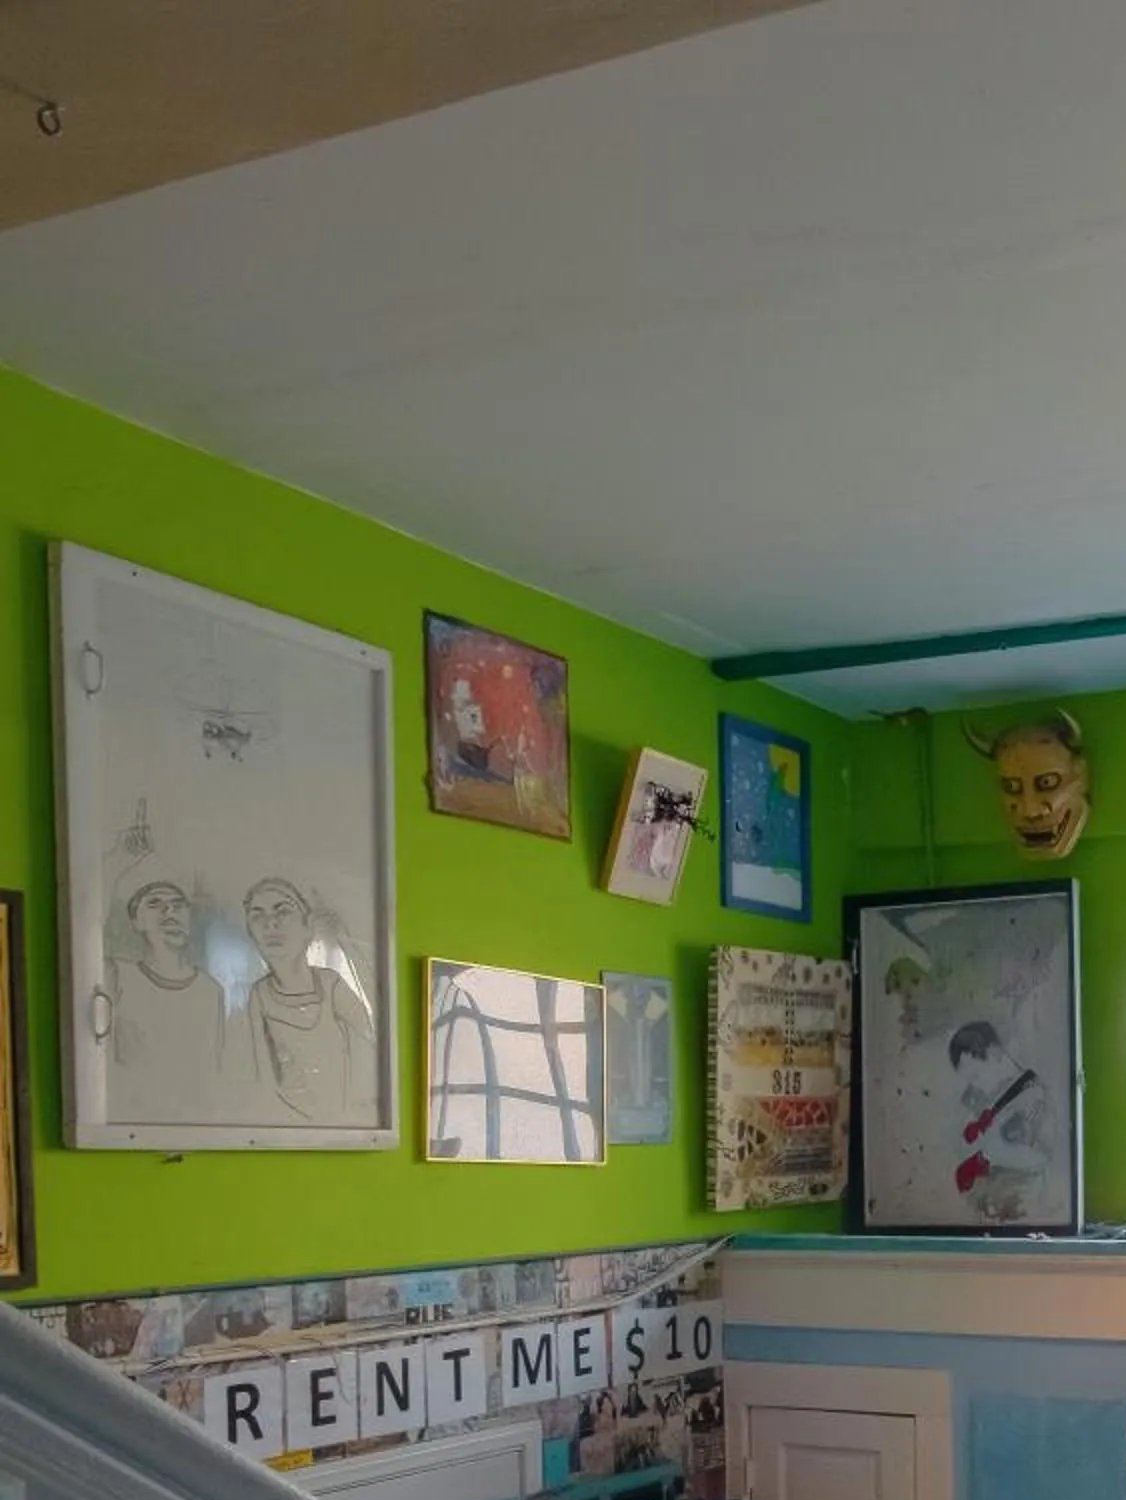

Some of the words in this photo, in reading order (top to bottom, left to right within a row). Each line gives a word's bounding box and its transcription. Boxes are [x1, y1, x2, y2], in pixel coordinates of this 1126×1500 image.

[226, 1347, 471, 1444] RENT
[511, 1327, 593, 1389] ME
[626, 1313, 711, 1380] $10
